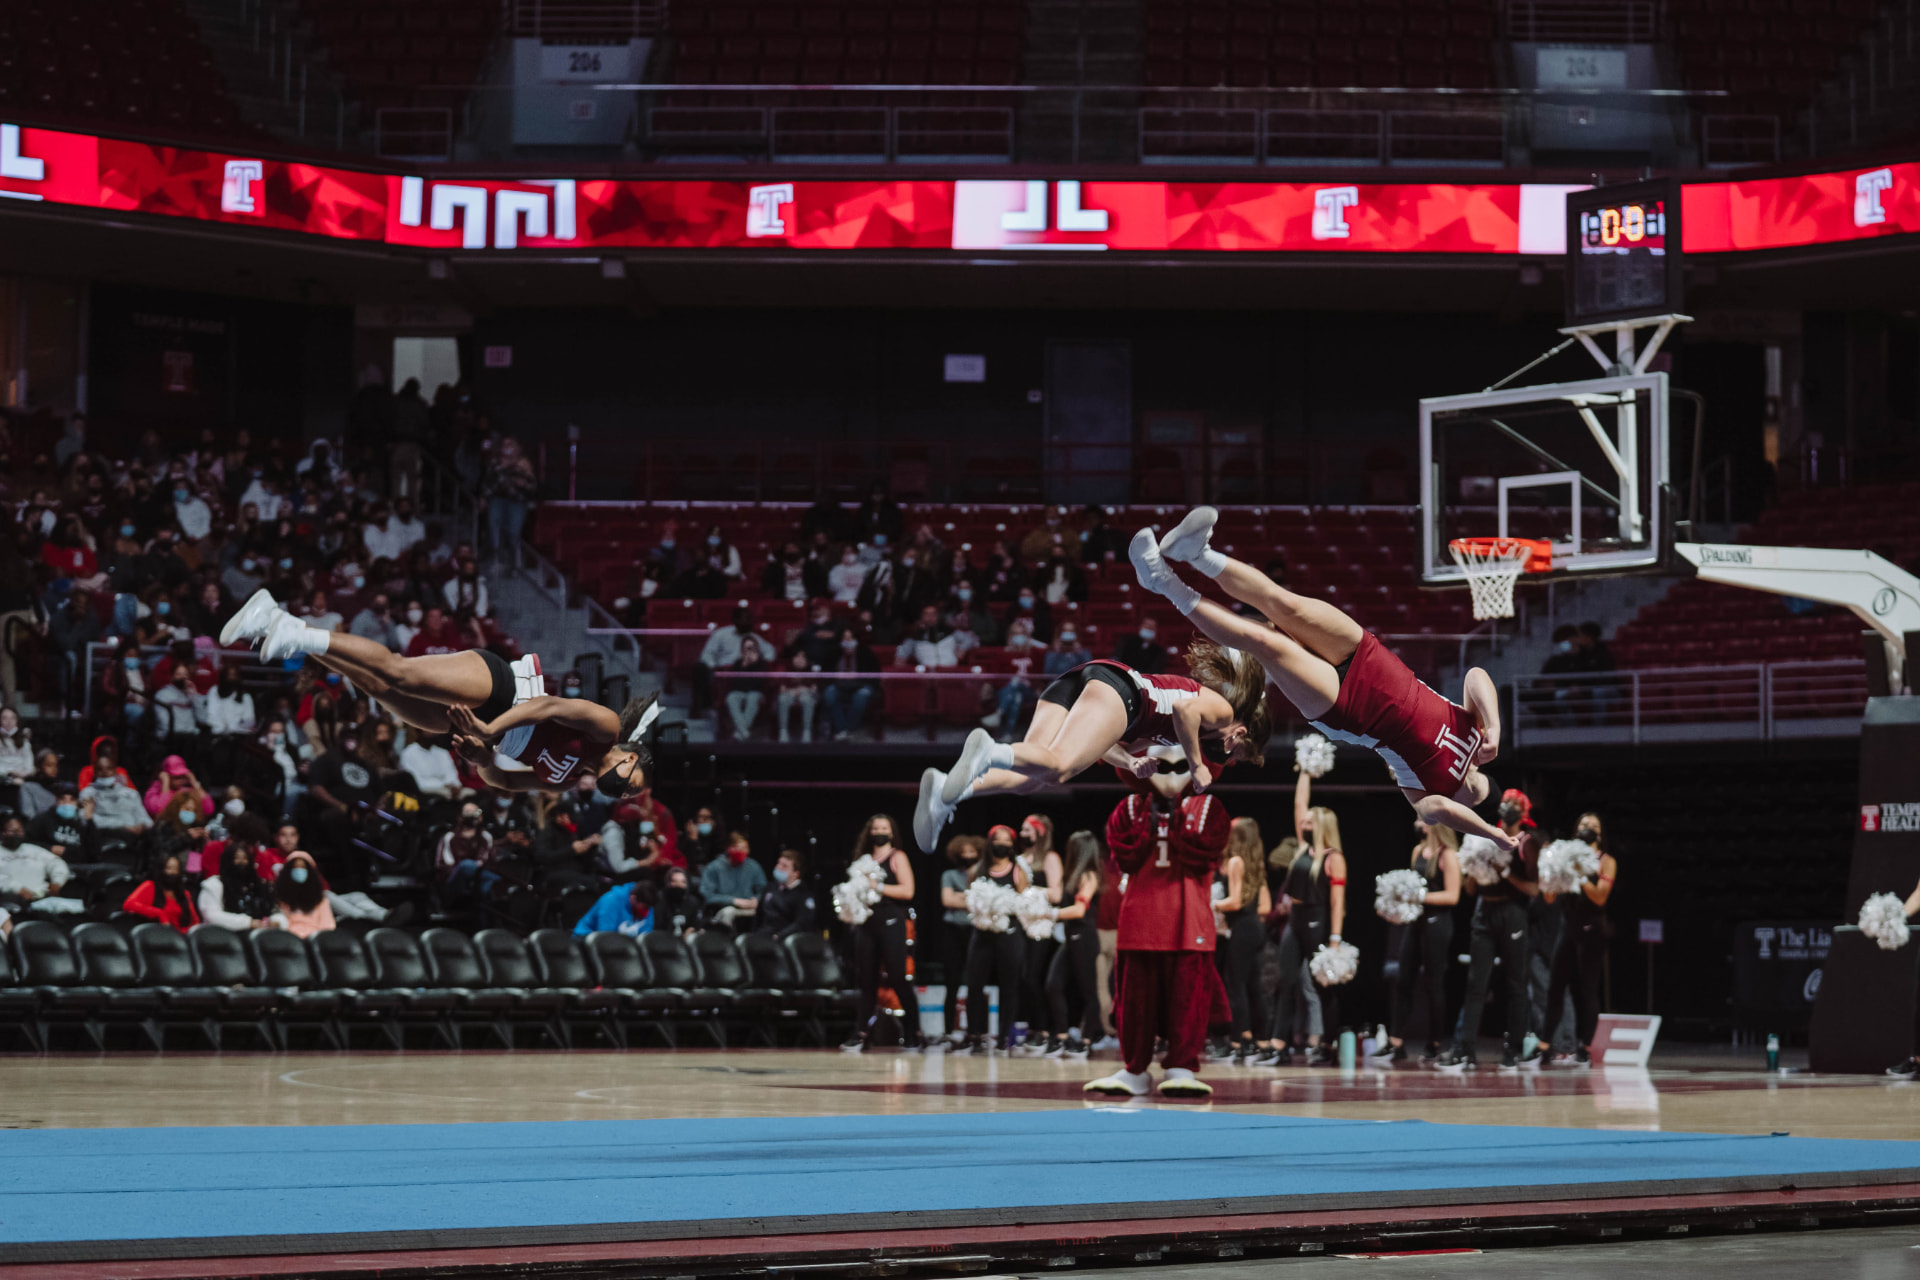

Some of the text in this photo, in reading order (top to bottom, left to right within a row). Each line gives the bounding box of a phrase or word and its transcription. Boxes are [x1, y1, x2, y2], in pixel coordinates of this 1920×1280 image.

[568, 51, 602, 73] 206
[1699, 546, 1752, 565] SPALDING
[1154, 840, 1172, 869] 1
[1778, 926, 1806, 948] The
